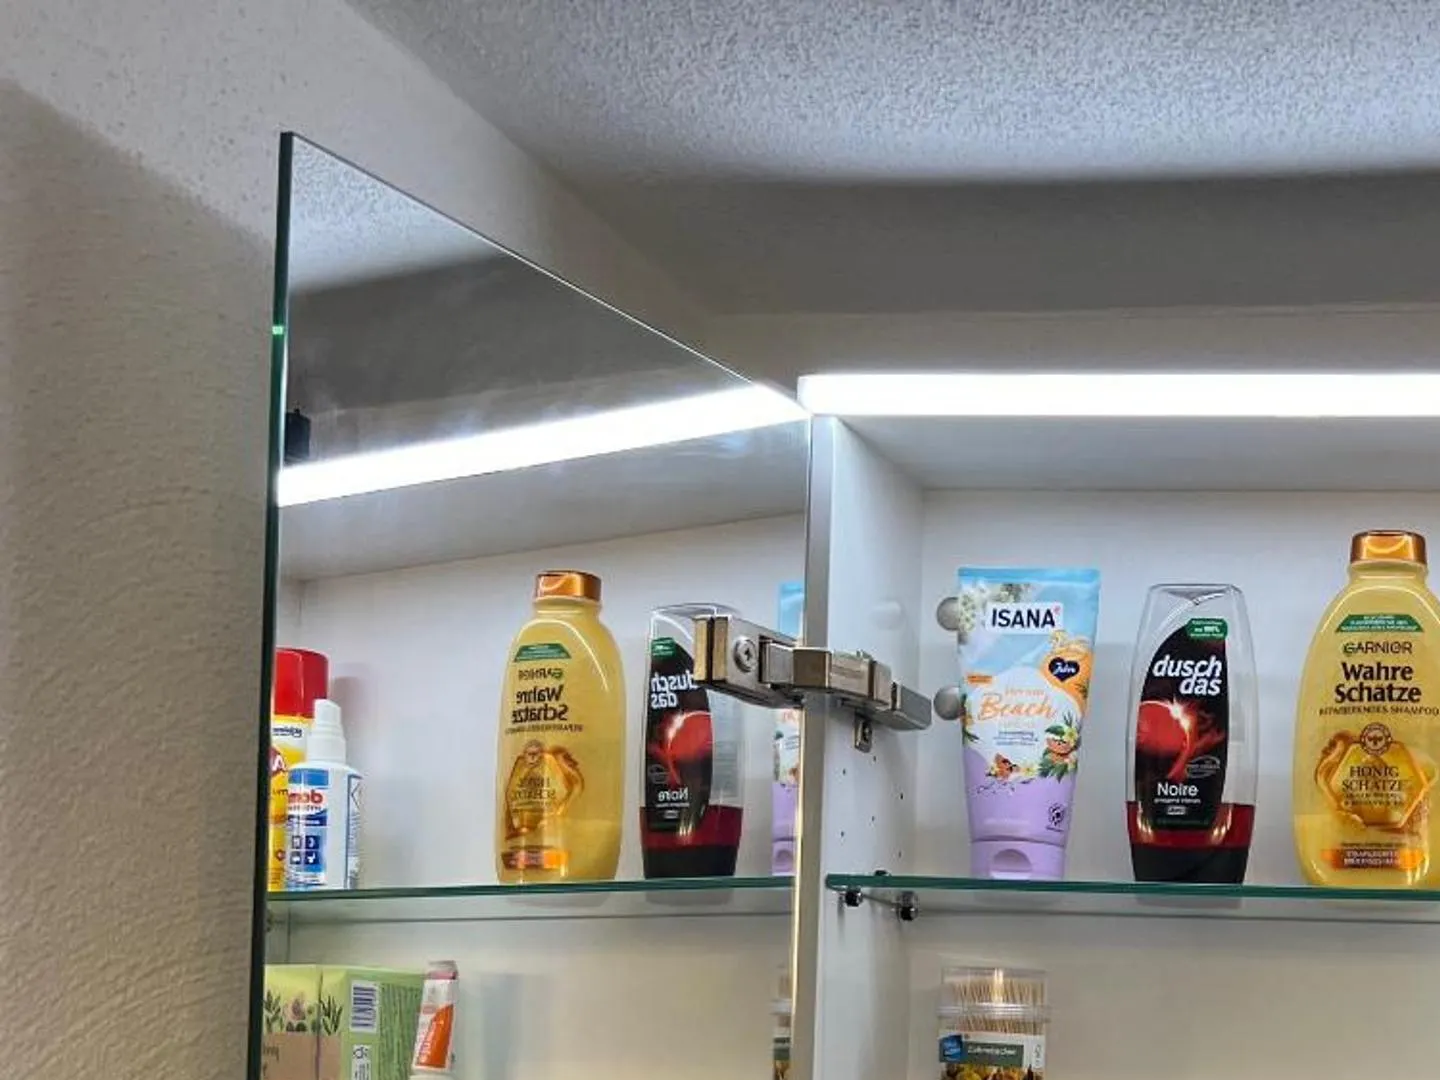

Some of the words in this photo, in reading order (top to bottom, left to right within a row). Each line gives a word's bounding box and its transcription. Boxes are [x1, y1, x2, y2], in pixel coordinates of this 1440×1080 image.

[991, 607, 1056, 629] ISANA
[1342, 641, 1413, 656] GARNIER
[1152, 653, 1222, 677] dusch
[1341, 661, 1414, 681] Wahre
[1179, 673, 1222, 696] das
[1157, 782, 1199, 797] Noire
